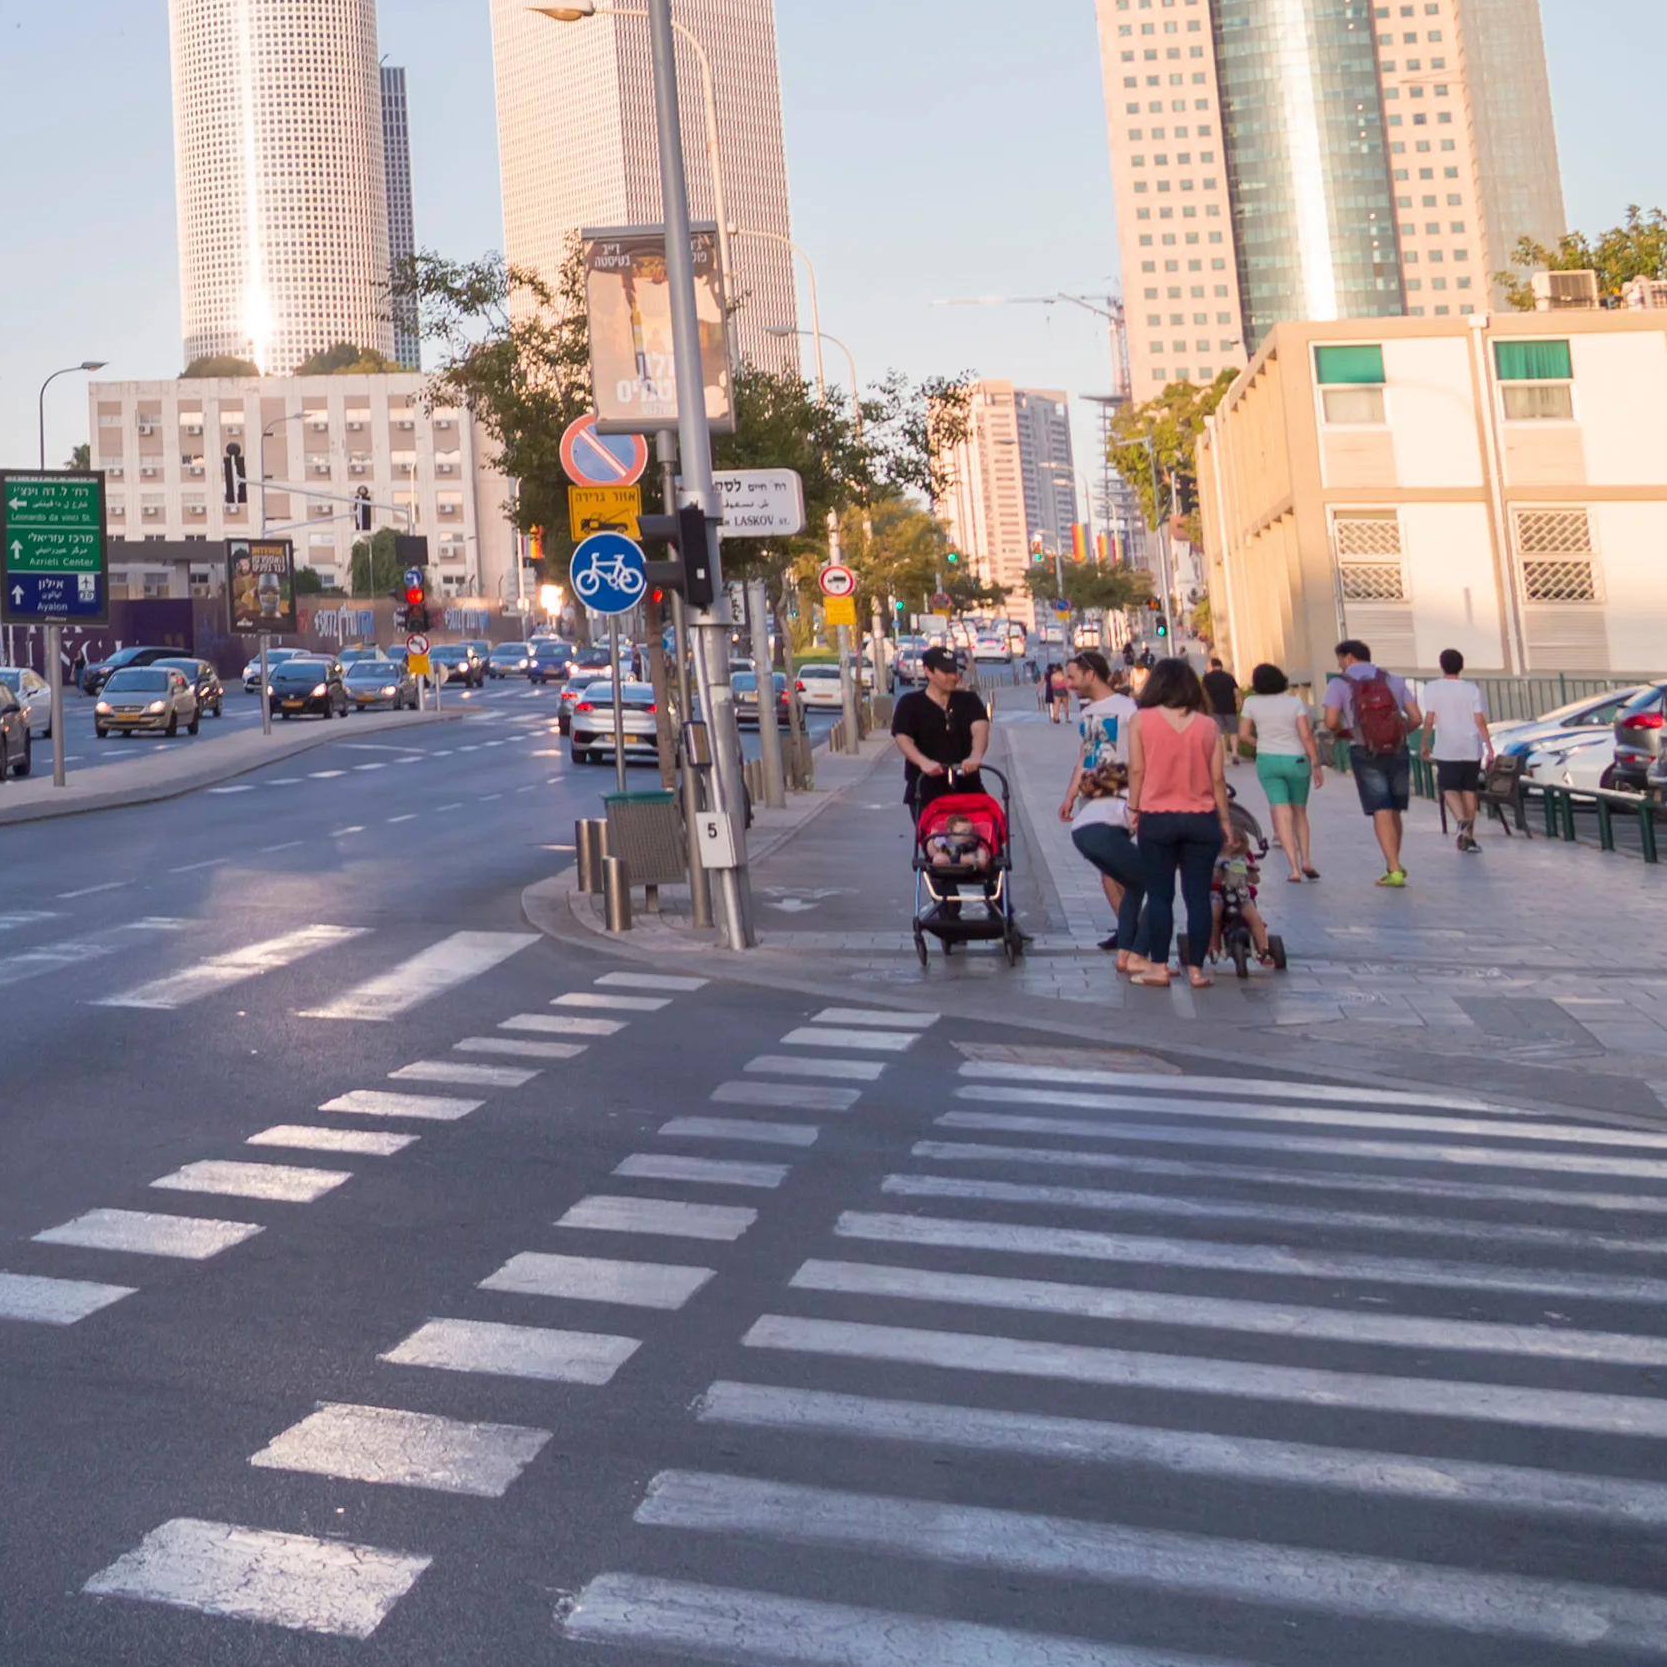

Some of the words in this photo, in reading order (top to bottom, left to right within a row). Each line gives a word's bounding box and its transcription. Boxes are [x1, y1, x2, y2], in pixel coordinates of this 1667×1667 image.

[42, 487, 55, 496] דה
[748, 482, 767, 492] חיים
[575, 491, 605, 502] גרירה
[613, 491, 636, 502] אזור
[11, 513, 46, 521] Leonardo
[49, 513, 59, 521] da
[734, 515, 774, 526] LASKOV
[28, 532, 65, 544] עזריאלי
[68, 534, 93, 543] מרכז
[29, 557, 59, 566] Azrieli
[63, 557, 94, 566] Center
[38, 578, 64, 590] אילון
[37, 602, 68, 612] Ayalon
[708, 822, 718, 839] 5
